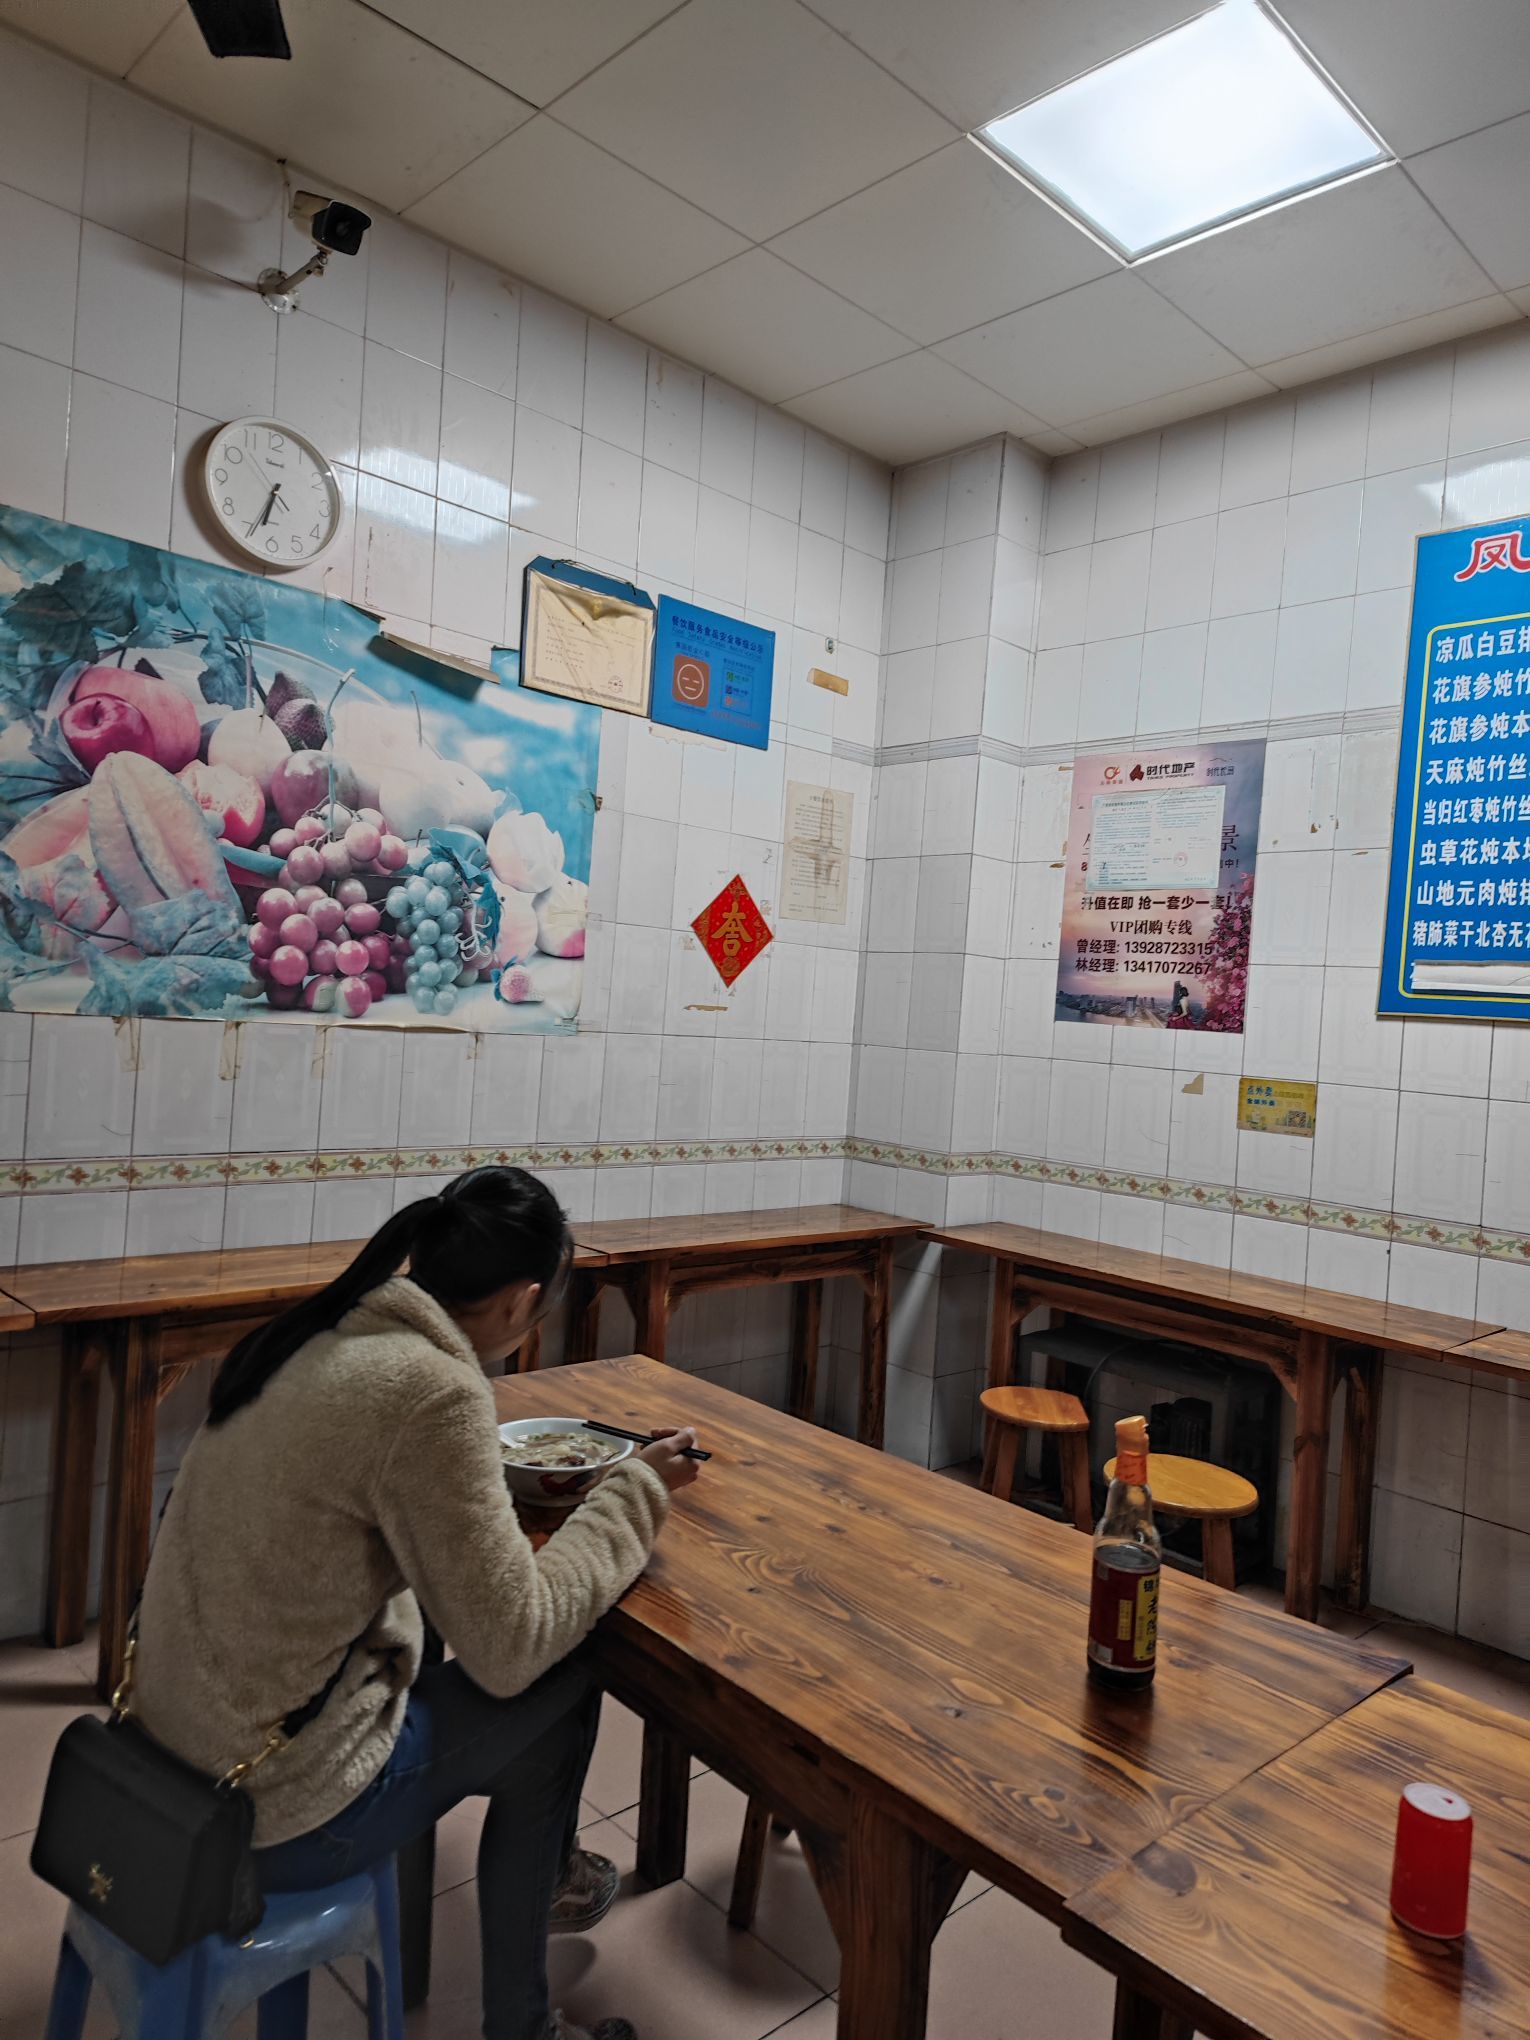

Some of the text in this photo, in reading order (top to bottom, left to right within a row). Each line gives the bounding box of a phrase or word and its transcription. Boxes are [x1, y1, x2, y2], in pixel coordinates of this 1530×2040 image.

[244, 428, 257, 450] 11
[268, 431, 285, 453] 12
[223, 443, 243, 465] 10
[214, 468, 229, 486] 9
[311, 471, 324, 491] 2
[222, 497, 235, 516] 8
[318, 499, 331, 518] 3
[309, 523, 321, 540] 4
[265, 536, 279, 553] 6
[291, 535, 304, 553] 5
[1432, 667, 1530, 704] 花旗参炖竹
[1429, 709, 1530, 745] 花旗参炖本
[1146, 762, 1195, 776] 时代地产
[1423, 794, 1530, 825] 当归红枣炖竹丝
[1081, 896, 1134, 911] 升值在即
[1110, 919, 1193, 936] VIP团购专线
[1076, 939, 1213, 956] 曾经理: 13928723315
[1075, 957, 1211, 975] 林经理: 13417072267
